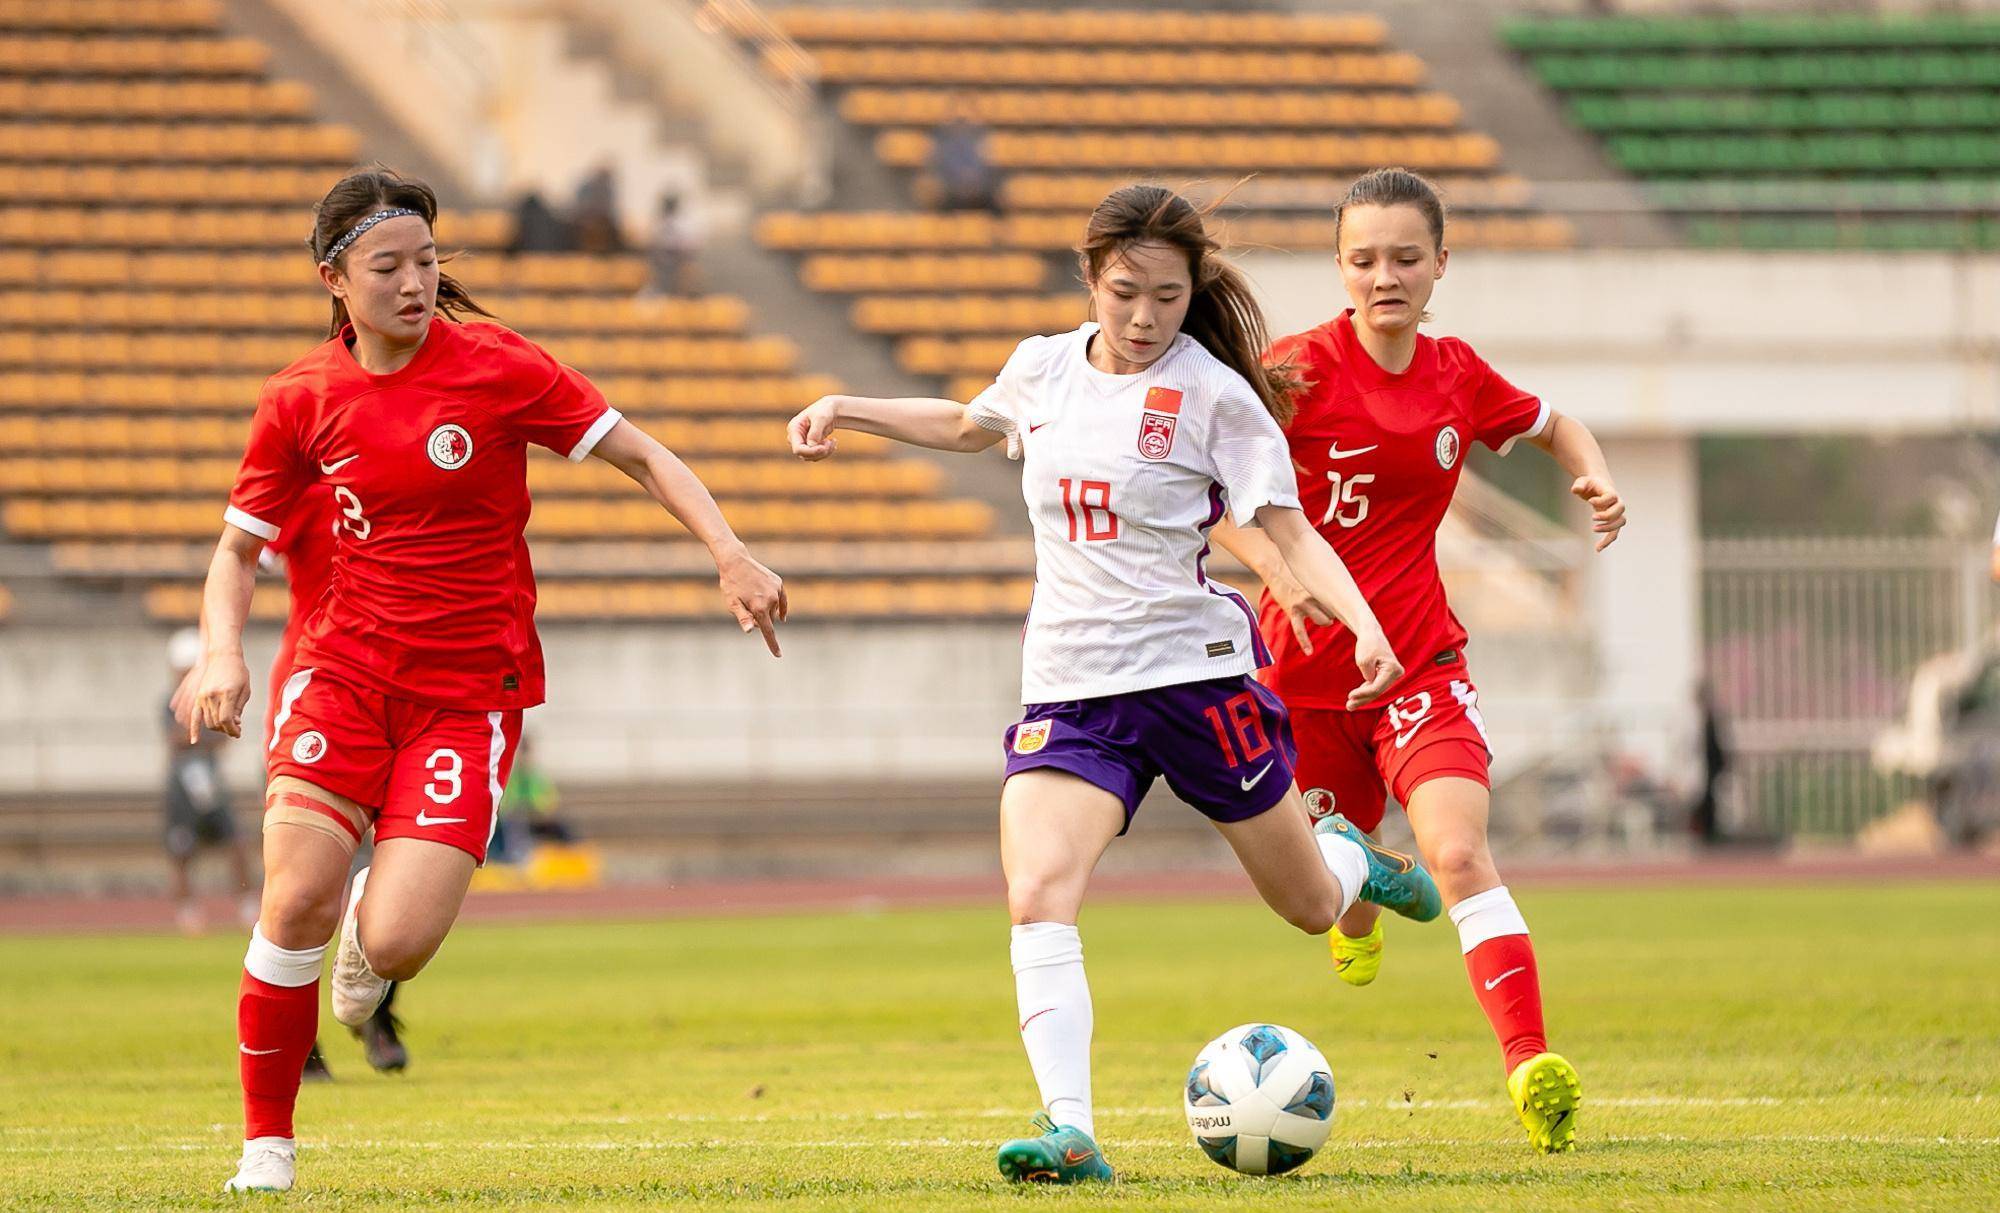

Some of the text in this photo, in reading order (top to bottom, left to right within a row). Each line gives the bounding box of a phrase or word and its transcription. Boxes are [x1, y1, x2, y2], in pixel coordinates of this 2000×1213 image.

[334, 485, 371, 540] 3
[1058, 478, 1118, 542] 18
[1323, 470, 1376, 528] 15
[1204, 691, 1273, 769] 18
[424, 748, 463, 805] 3
